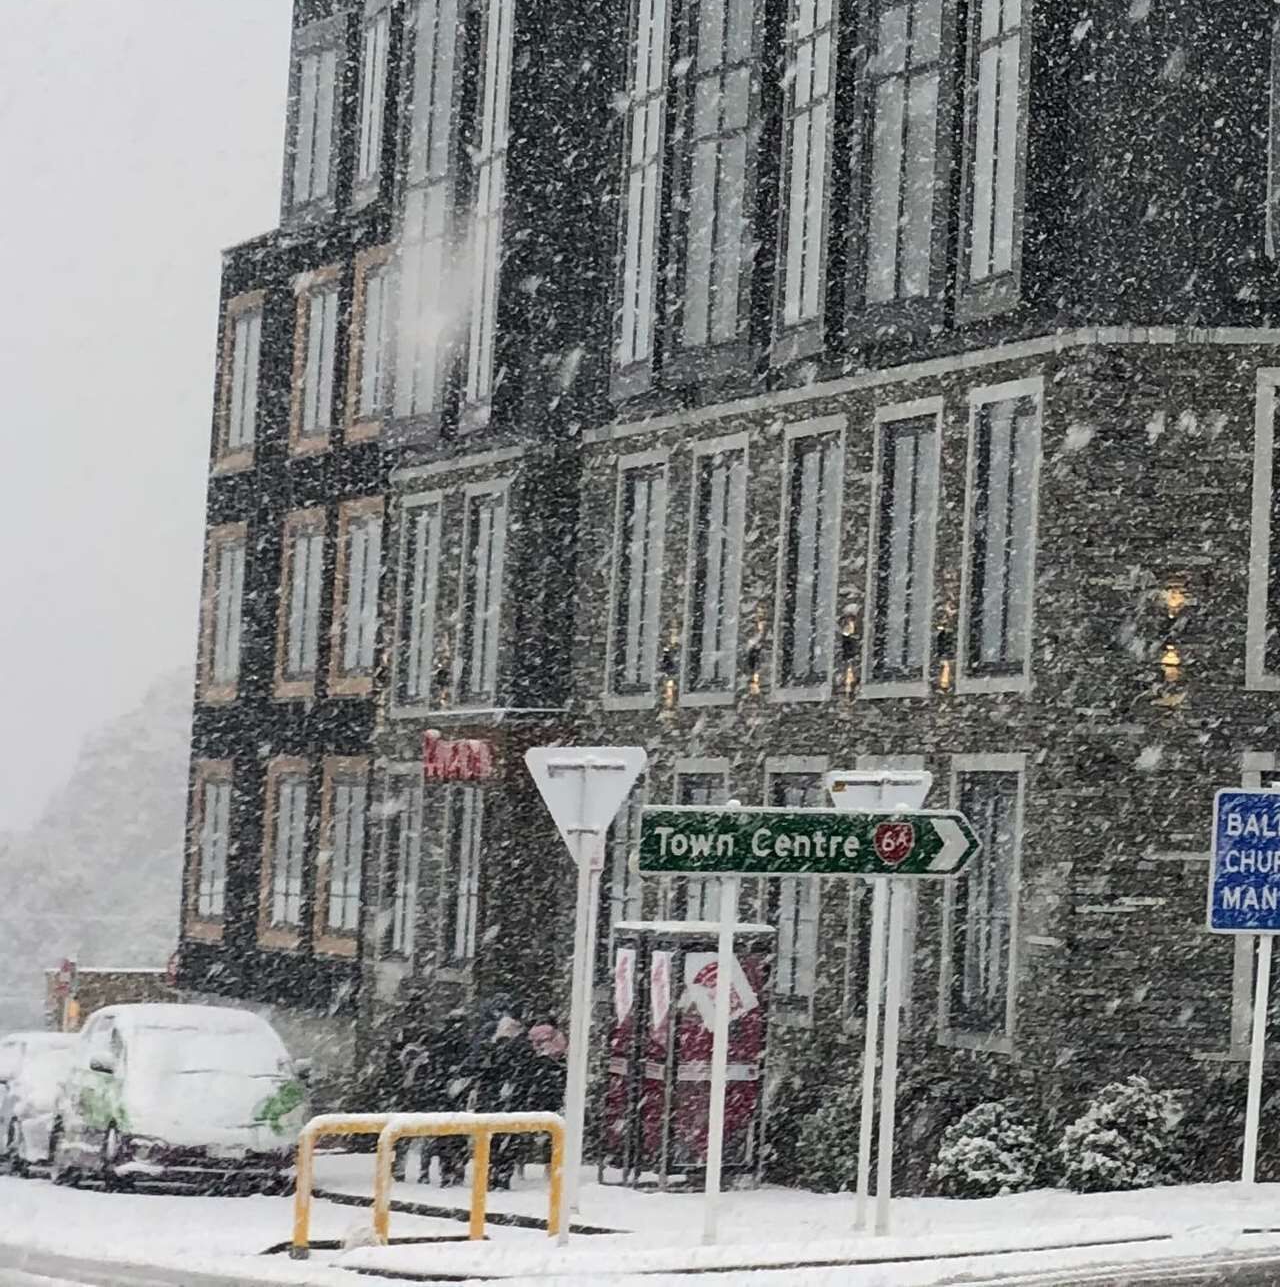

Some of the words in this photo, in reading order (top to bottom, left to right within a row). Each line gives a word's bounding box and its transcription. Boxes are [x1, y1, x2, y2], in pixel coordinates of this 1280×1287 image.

[655, 826, 735, 857] Town
[751, 827, 860, 858] Centre
[1222, 886, 1277, 910] MAN
